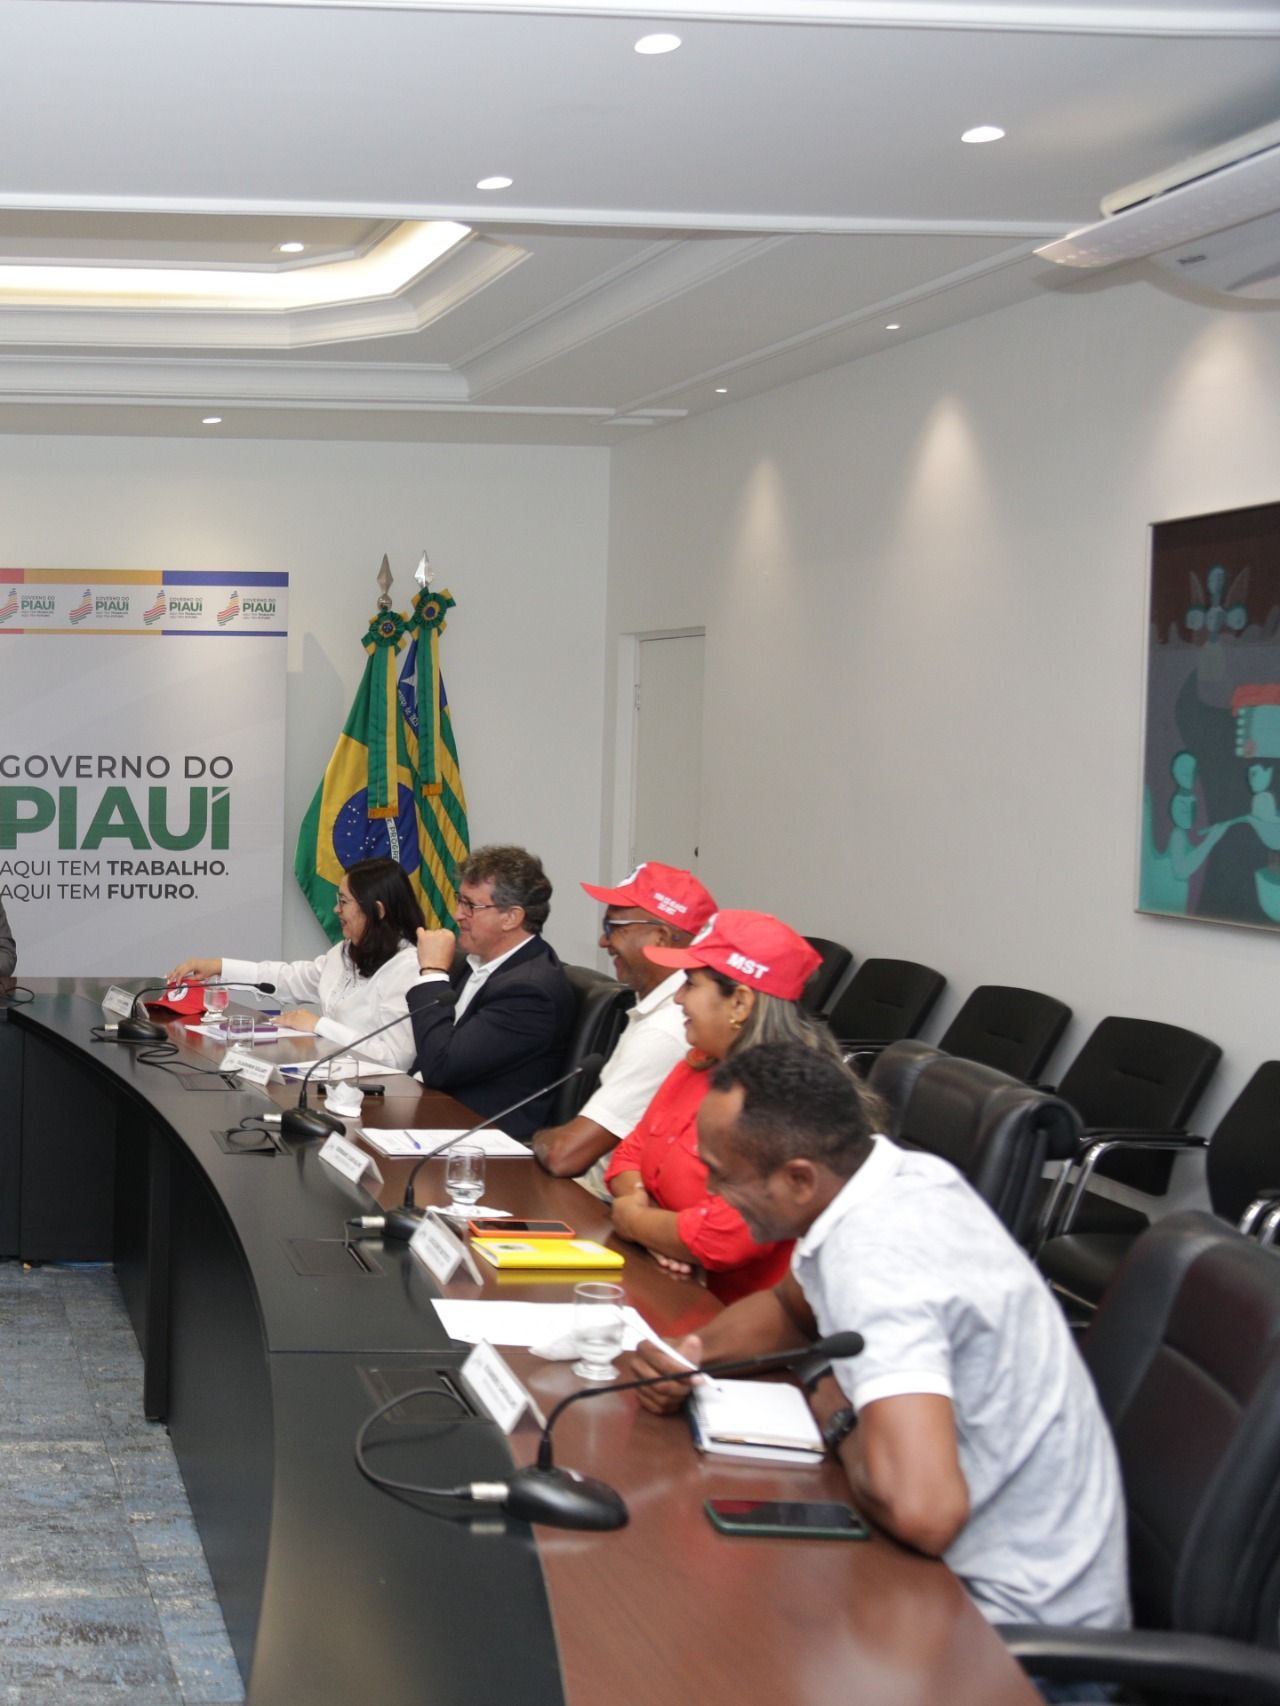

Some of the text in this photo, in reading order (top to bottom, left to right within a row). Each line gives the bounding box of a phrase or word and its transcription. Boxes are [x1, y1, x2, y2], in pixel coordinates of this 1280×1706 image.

[0, 755, 234, 779] GOVERNO DO
[57, 860, 100, 876] TEM
[106, 860, 229, 876] TRABALHO.
[0, 883, 199, 903] AQUI TEM FUTURO.
[726, 952, 770, 979] MST
